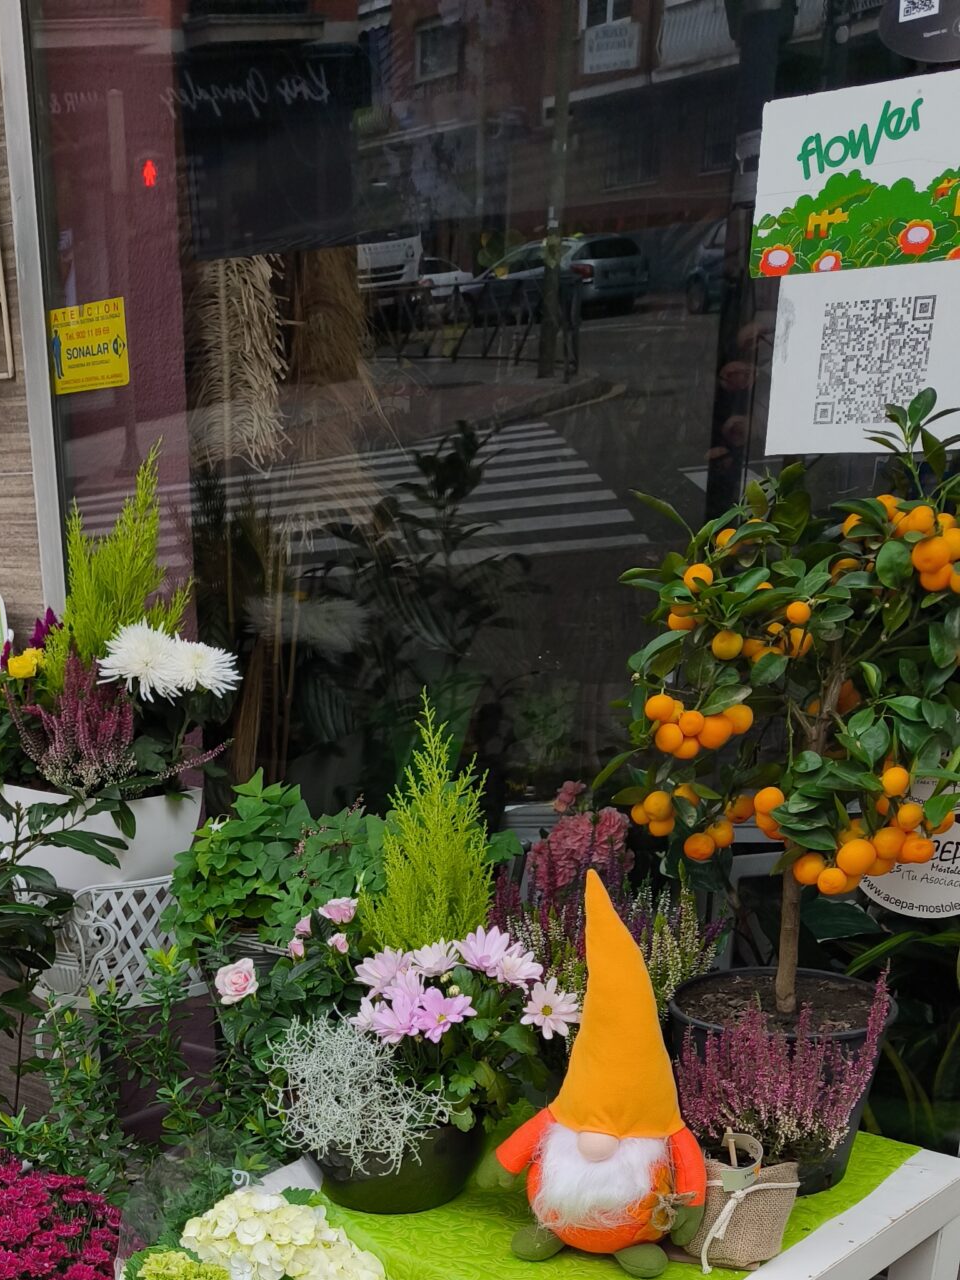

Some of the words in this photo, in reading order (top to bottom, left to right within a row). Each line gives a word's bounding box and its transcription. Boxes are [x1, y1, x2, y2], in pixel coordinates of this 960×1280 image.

[797, 98, 924, 180] flower
[66, 342, 109, 360] SONALAR
[931, 862, 960, 875] Móstole
[920, 872, 960, 888] Asociac
[862, 876, 960, 914] ww.acepa-mostole
